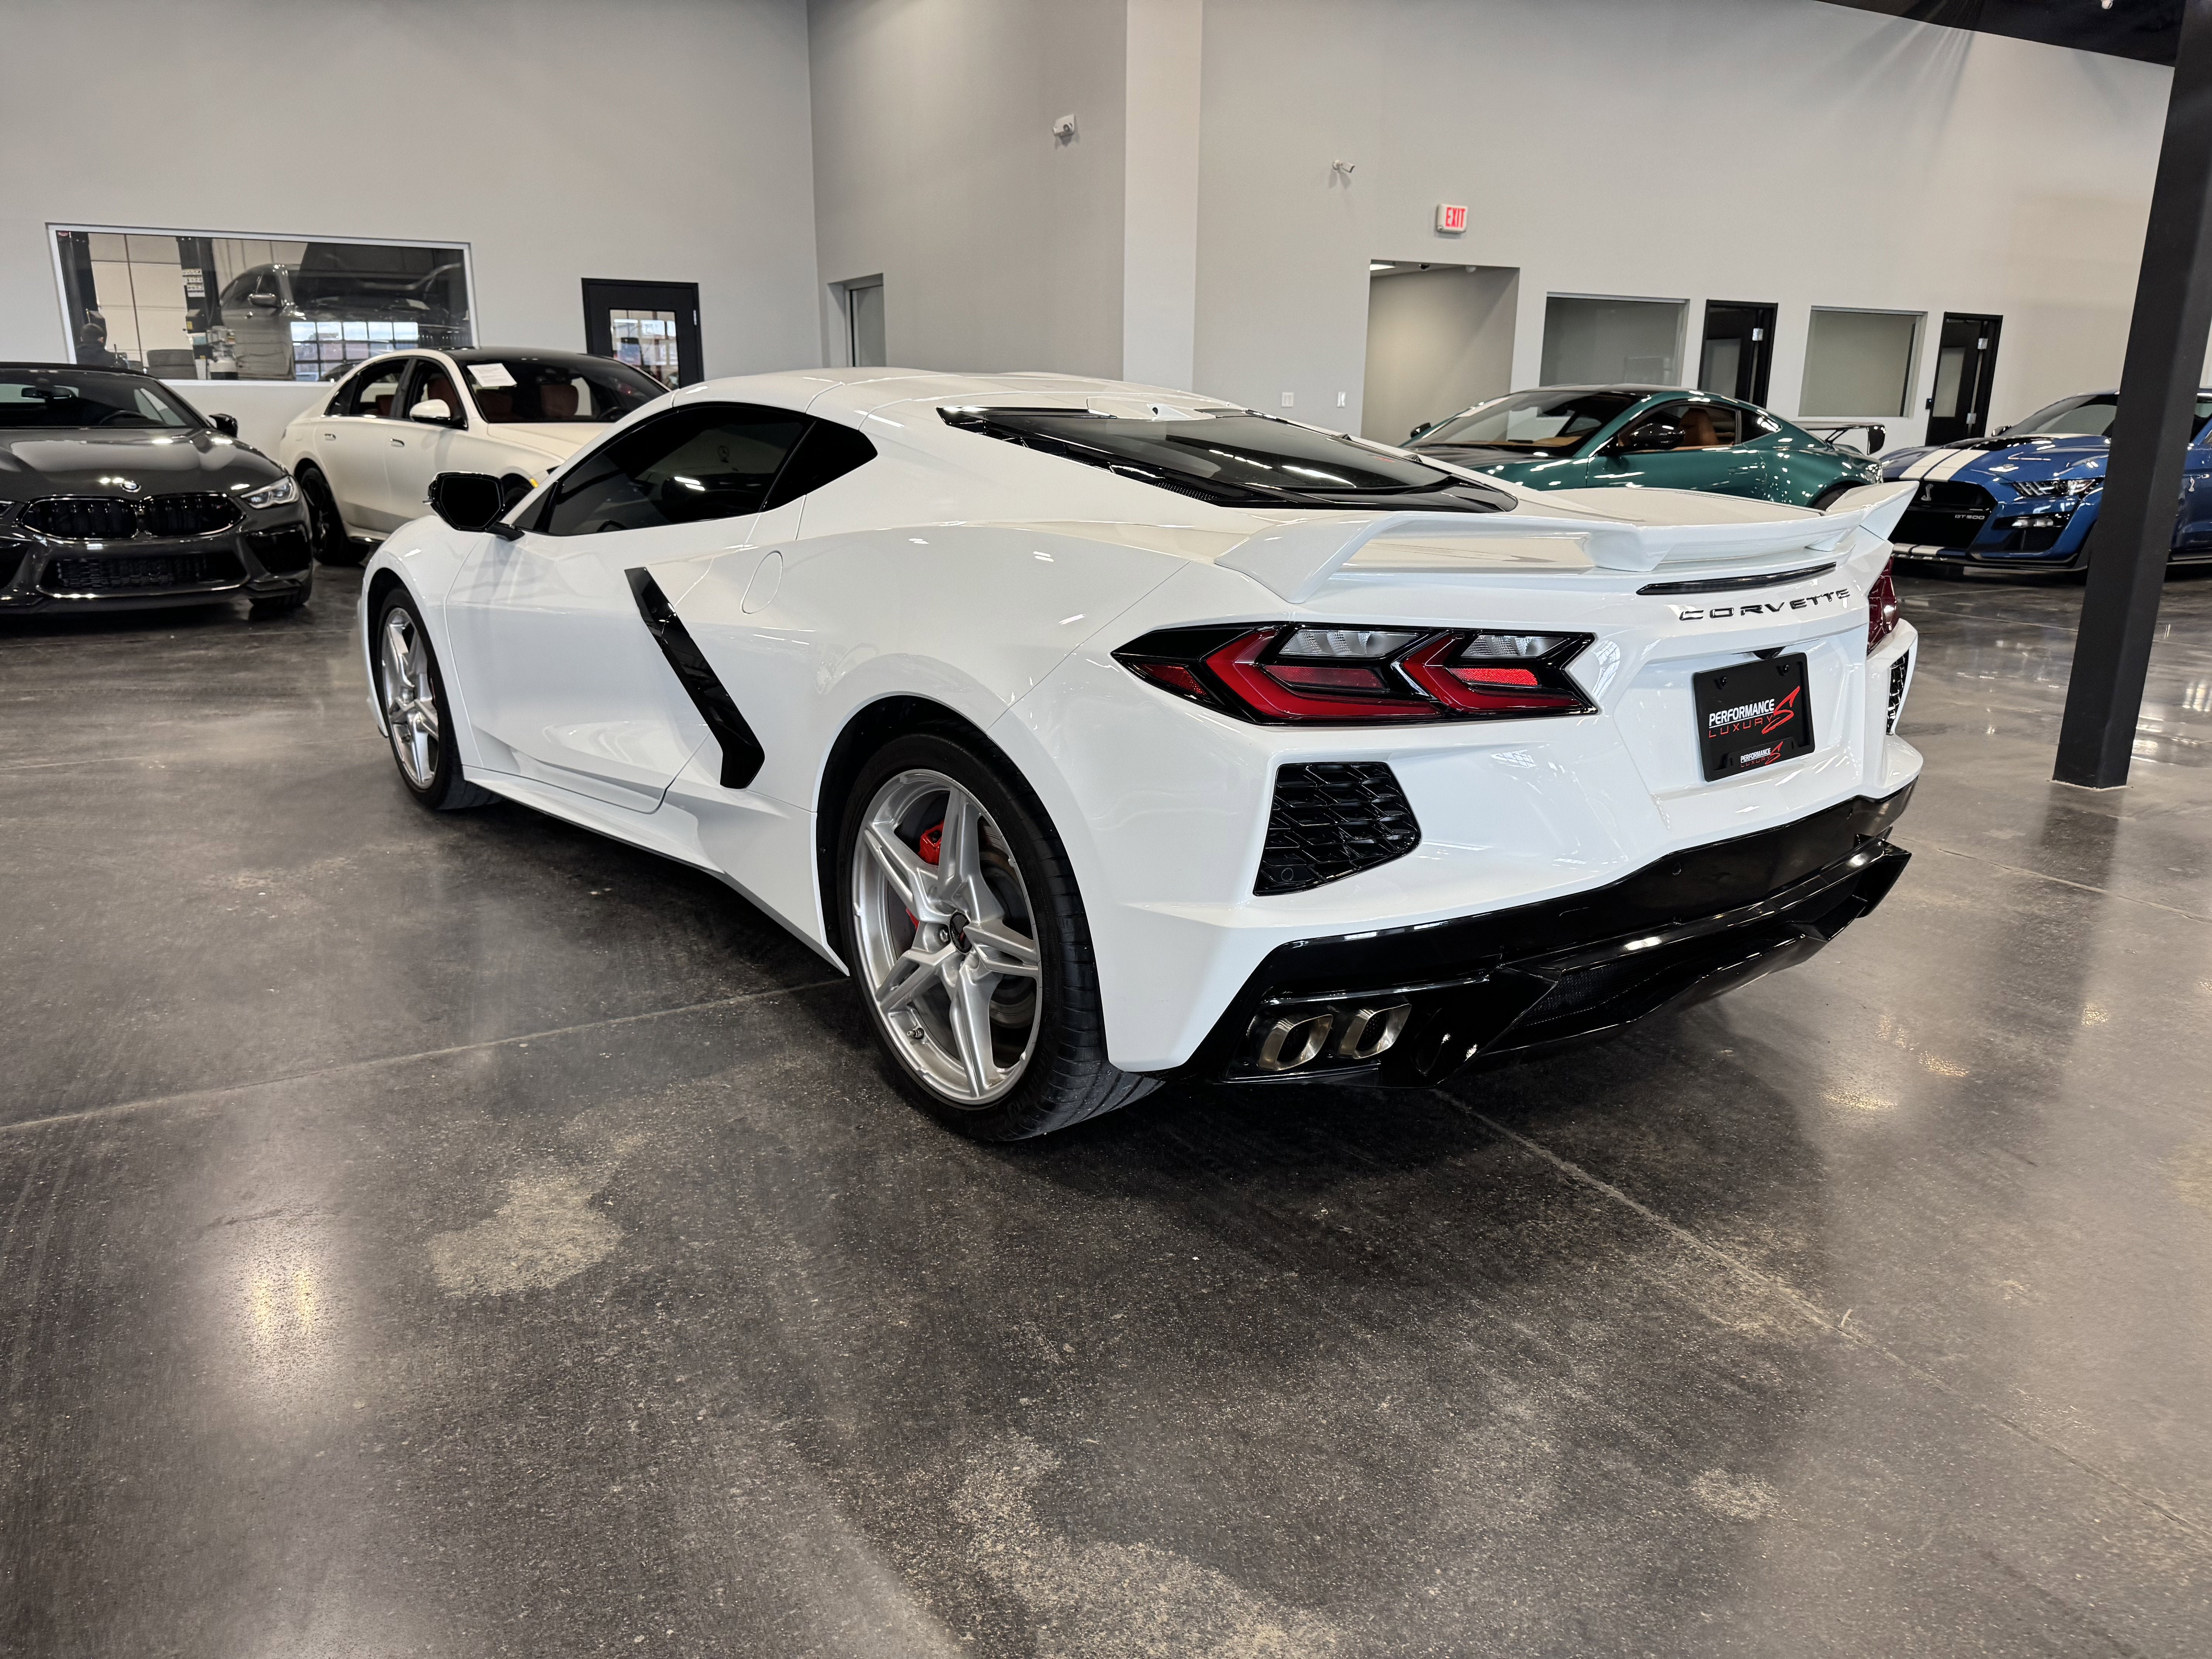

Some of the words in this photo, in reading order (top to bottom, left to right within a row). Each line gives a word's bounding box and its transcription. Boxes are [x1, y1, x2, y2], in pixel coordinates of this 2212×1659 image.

[1446, 207, 1465, 228] EXIT
[1679, 588, 1850, 621] CORVETTE
[1709, 698, 1775, 726] PERFORMANCE
[1709, 714, 1774, 738] LUXURY
[1740, 747, 1771, 763] PERFORMANCE
